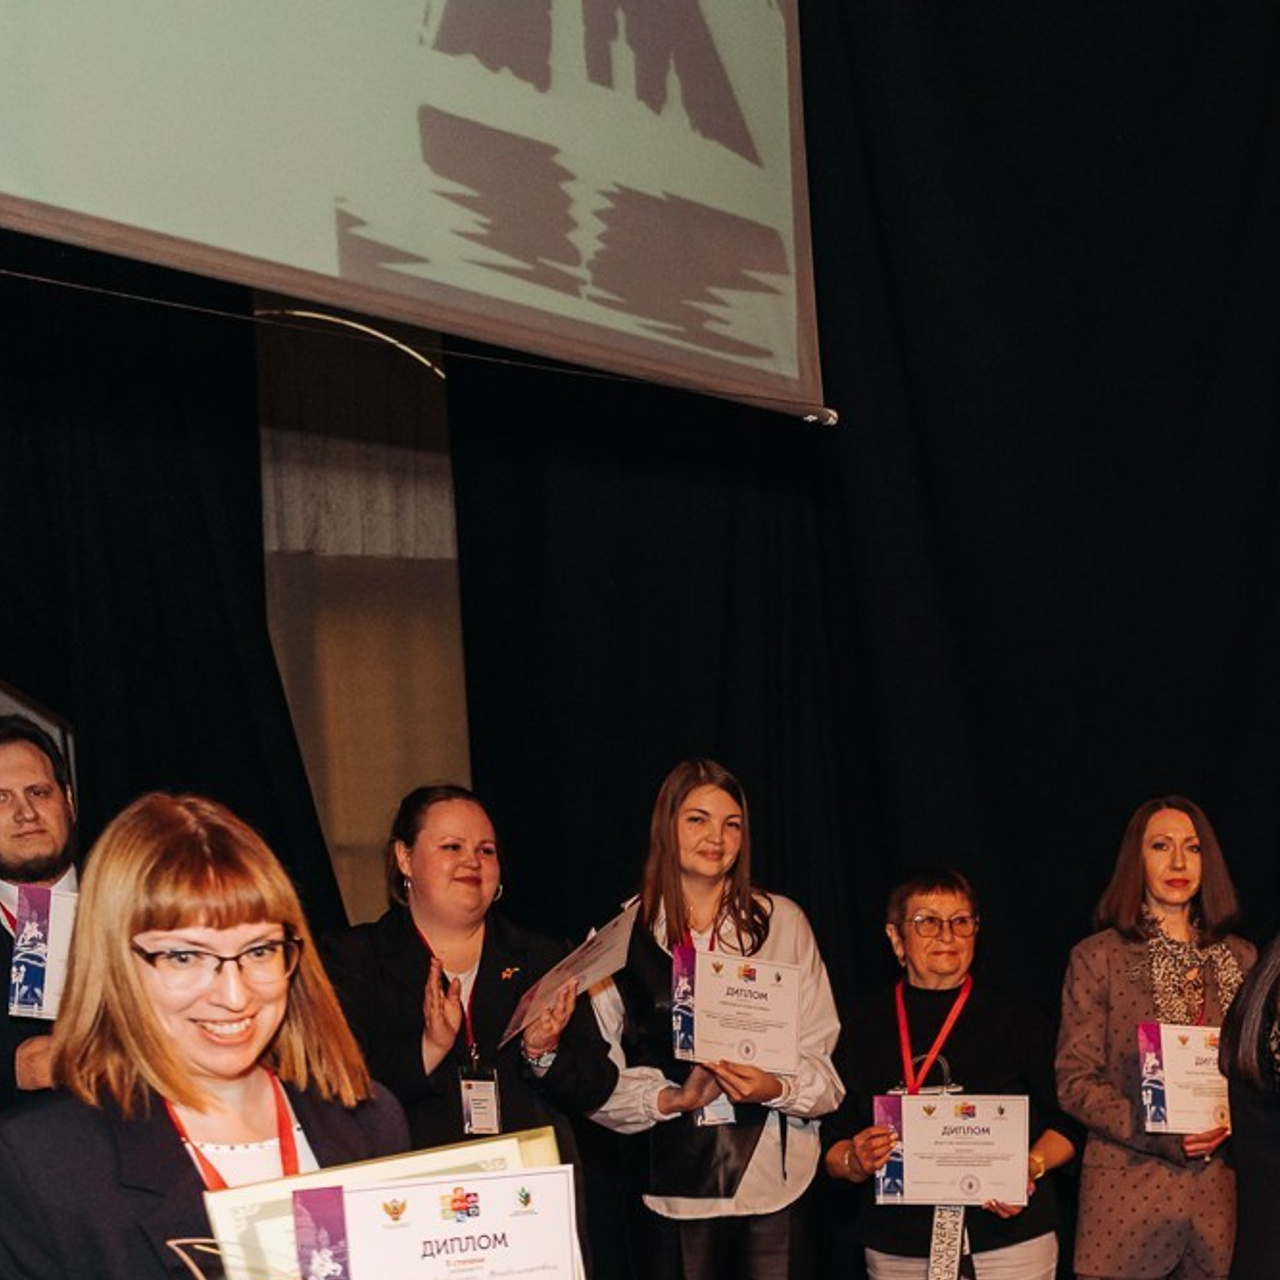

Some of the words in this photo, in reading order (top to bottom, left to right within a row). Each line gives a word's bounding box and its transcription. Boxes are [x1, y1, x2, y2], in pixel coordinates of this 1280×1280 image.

[725, 986, 768, 1000] ДИПЛОМ
[941, 1125, 990, 1136] ДИПЛОМ
[421, 1232, 509, 1260] ДИПЛОМ
